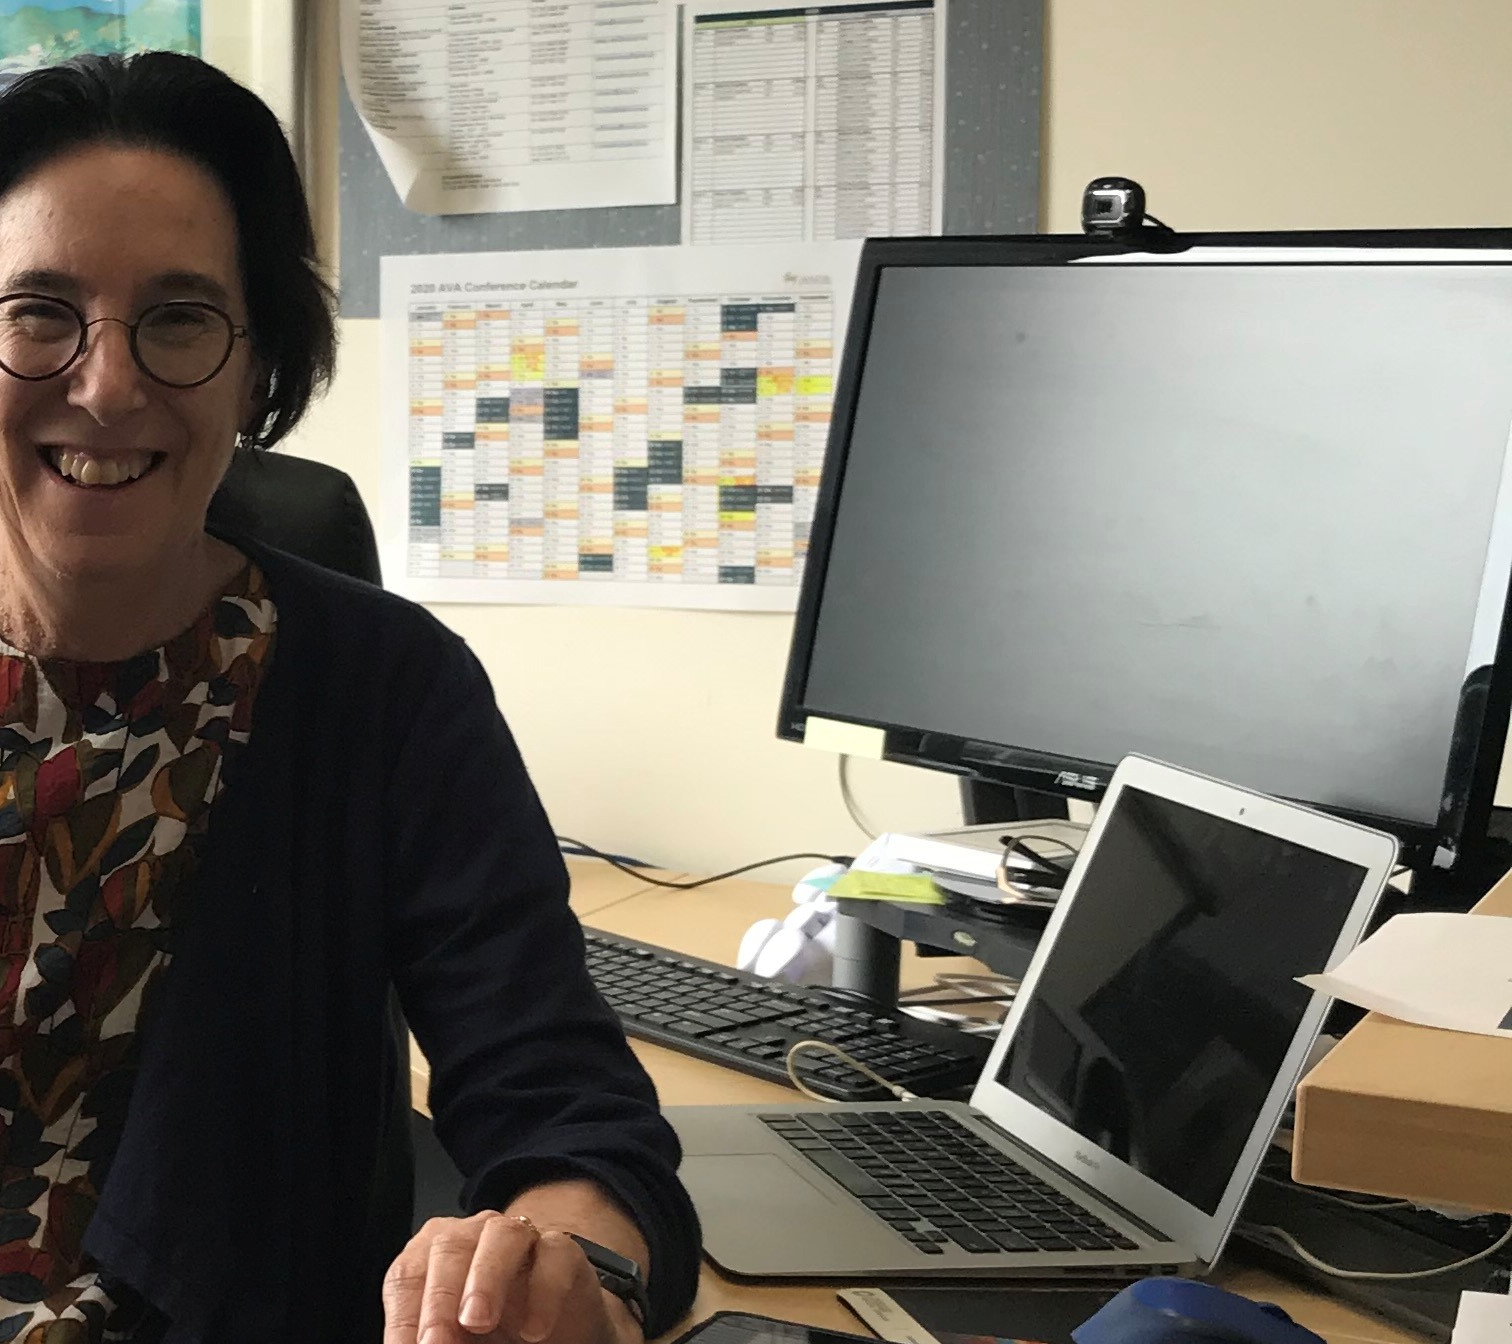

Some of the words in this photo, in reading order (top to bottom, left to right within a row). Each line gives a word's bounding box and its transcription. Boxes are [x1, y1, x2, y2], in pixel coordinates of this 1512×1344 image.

[438, 281, 462, 294] AVA
[464, 279, 527, 293] Conference
[529, 278, 579, 291] Calendar
[1054, 770, 1100, 791] ASUS
